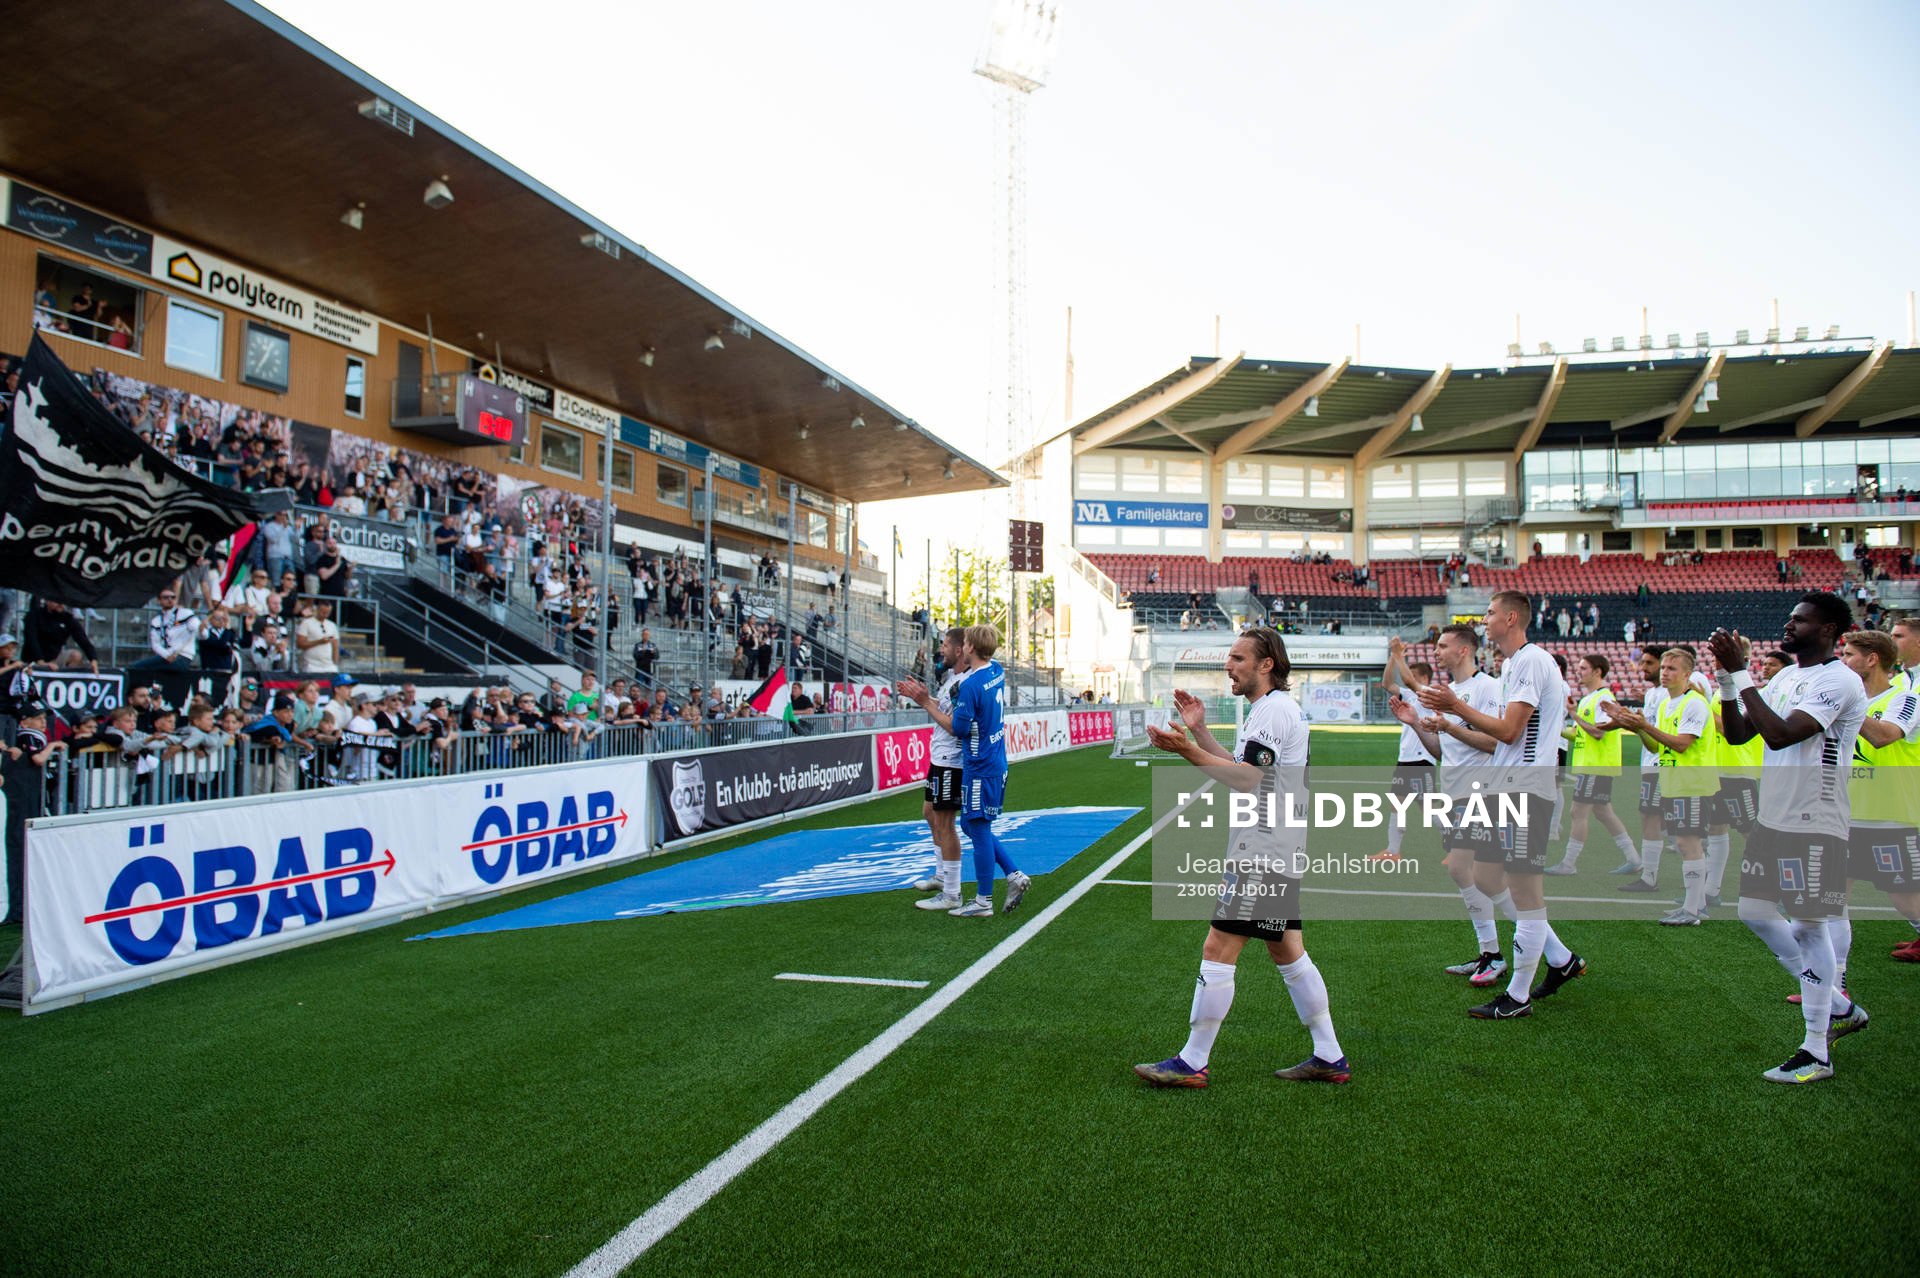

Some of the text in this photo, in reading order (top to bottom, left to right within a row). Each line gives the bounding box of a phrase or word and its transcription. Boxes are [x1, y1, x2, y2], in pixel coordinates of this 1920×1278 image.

[208, 270, 304, 320] polyterm
[1076, 502, 1204, 524] NA Familjeläktare
[329, 518, 406, 553] Partners
[1318, 651, 1340, 660] sedan
[1342, 652, 1361, 660] 1914
[36, 680, 117, 710] 100%
[716, 781, 733, 807] En
[734, 772, 772, 803] klubb
[779, 766, 797, 794] två
[797, 761, 864, 791] anläggningar
[1848, 767, 1875, 779] ECT
[104, 783, 617, 966] ÖBAB ÖBAB
